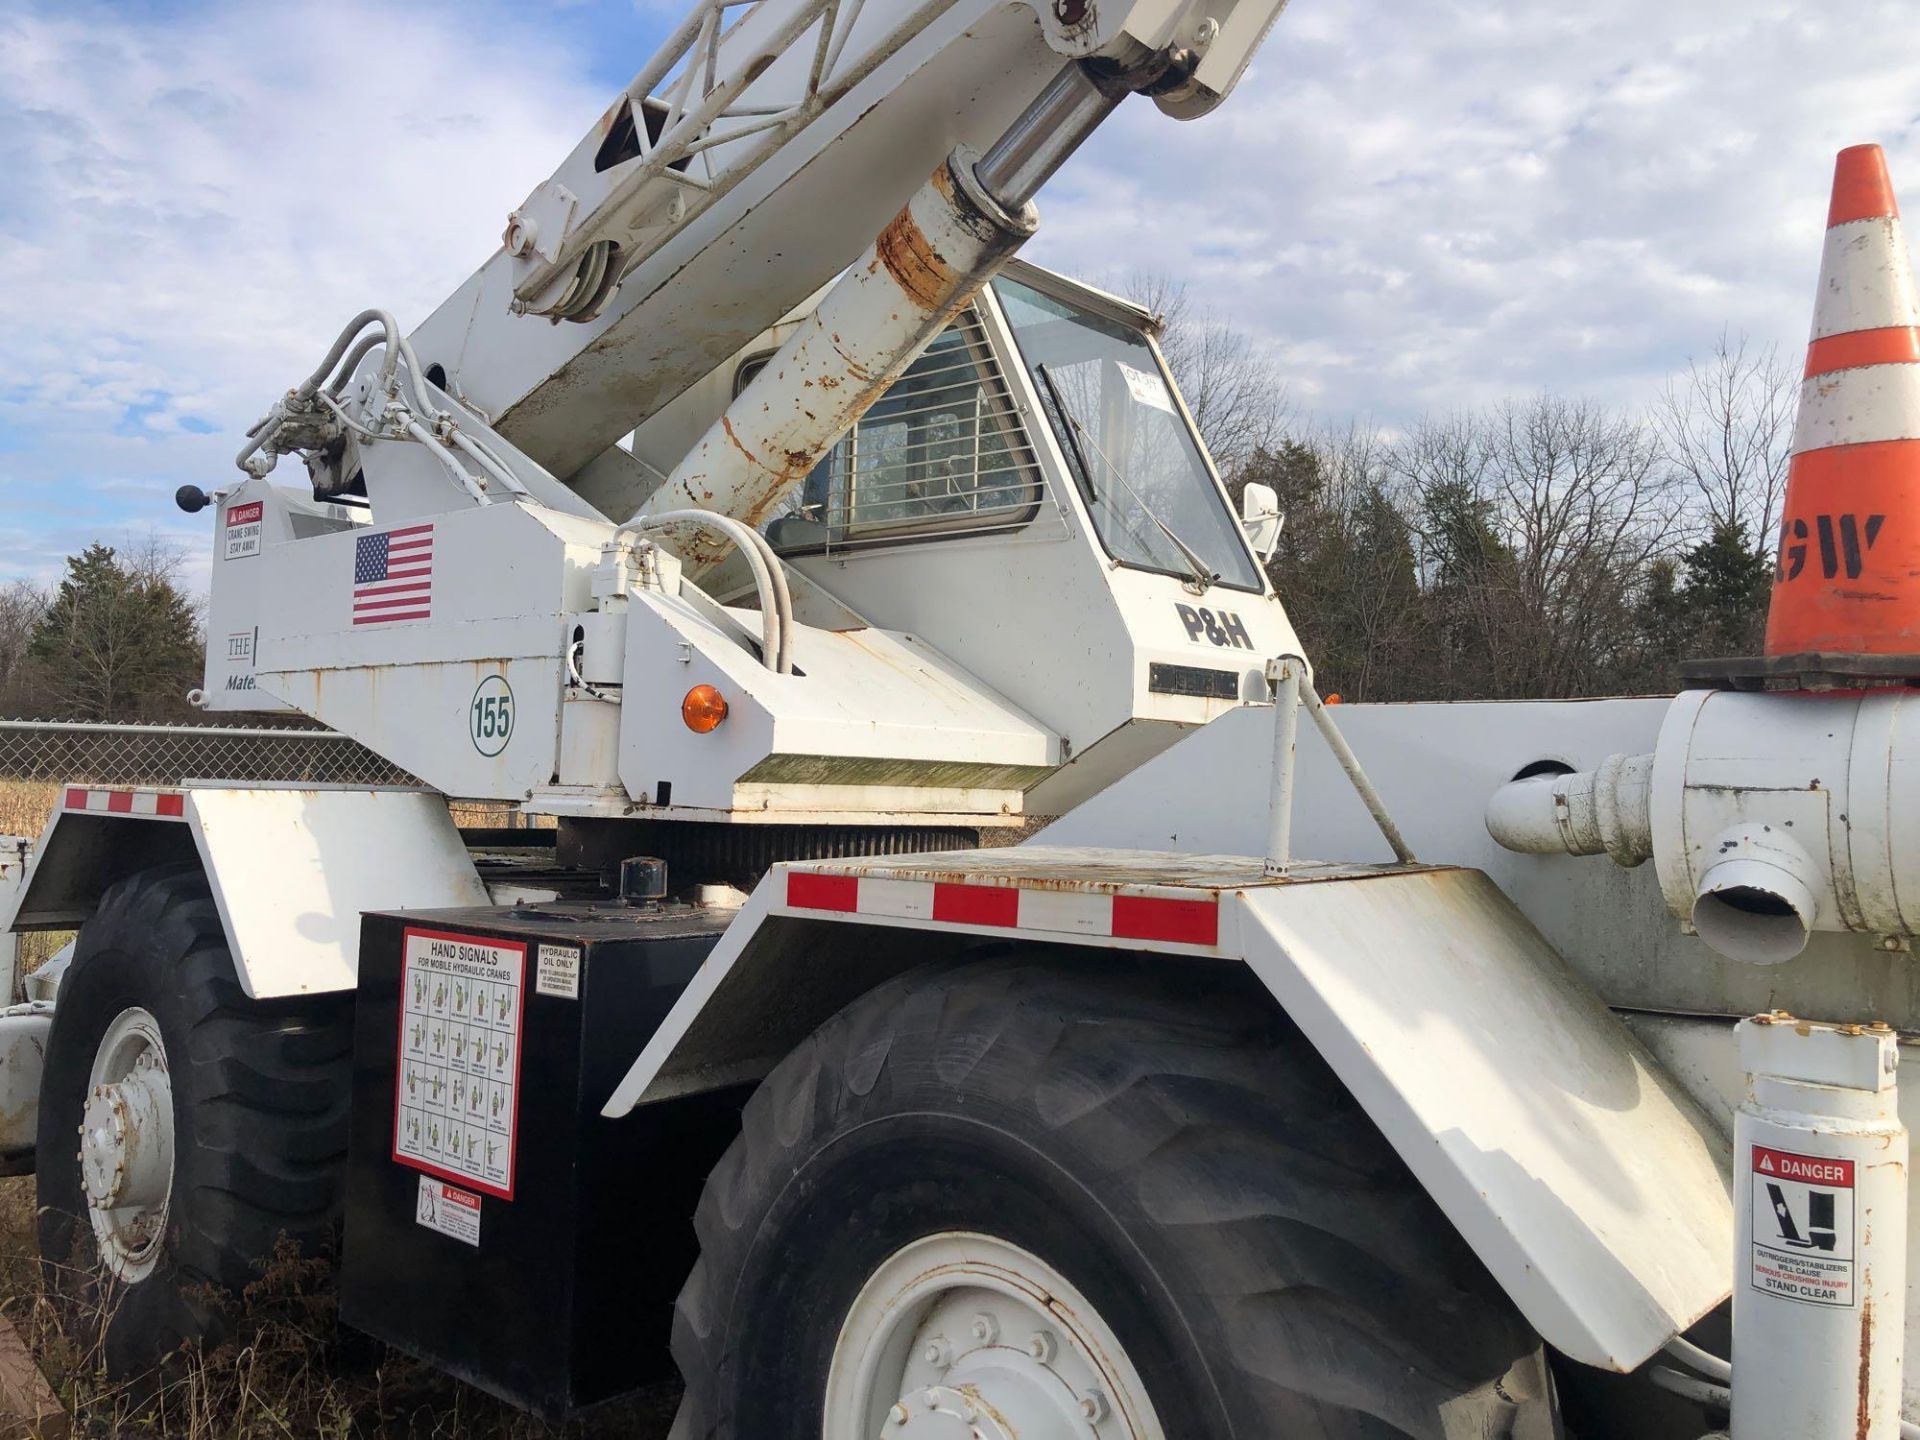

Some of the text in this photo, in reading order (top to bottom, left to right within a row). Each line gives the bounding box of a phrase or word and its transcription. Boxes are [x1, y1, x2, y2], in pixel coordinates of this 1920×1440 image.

[238, 507, 260, 521] DANGER
[228, 525, 260, 541] CRANE SWING
[230, 540, 255, 554] STAY AWAY
[1174, 602, 1255, 650] P&H
[228, 637, 250, 656] THE
[225, 674, 257, 691] Mate
[474, 696, 510, 738] 155
[431, 941, 499, 966] HAND SIGNALS
[540, 947, 578, 959] HYDRAULIC
[418, 957, 511, 981] FOR MOBILE HYDRAULIC CRANES
[543, 957, 573, 969] OIL ONLY
[1781, 1159, 1844, 1181] DANGER
[452, 1191, 475, 1206] DANGER
[1757, 1249, 1848, 1273] OUTRIGGERS/STABILIZERS
[1777, 1263, 1822, 1278] WILL CAUSE
[1755, 1264, 1849, 1289] SERIOUS CRUSHING INJURY
[1765, 1278, 1837, 1300] STAND CLEAR
